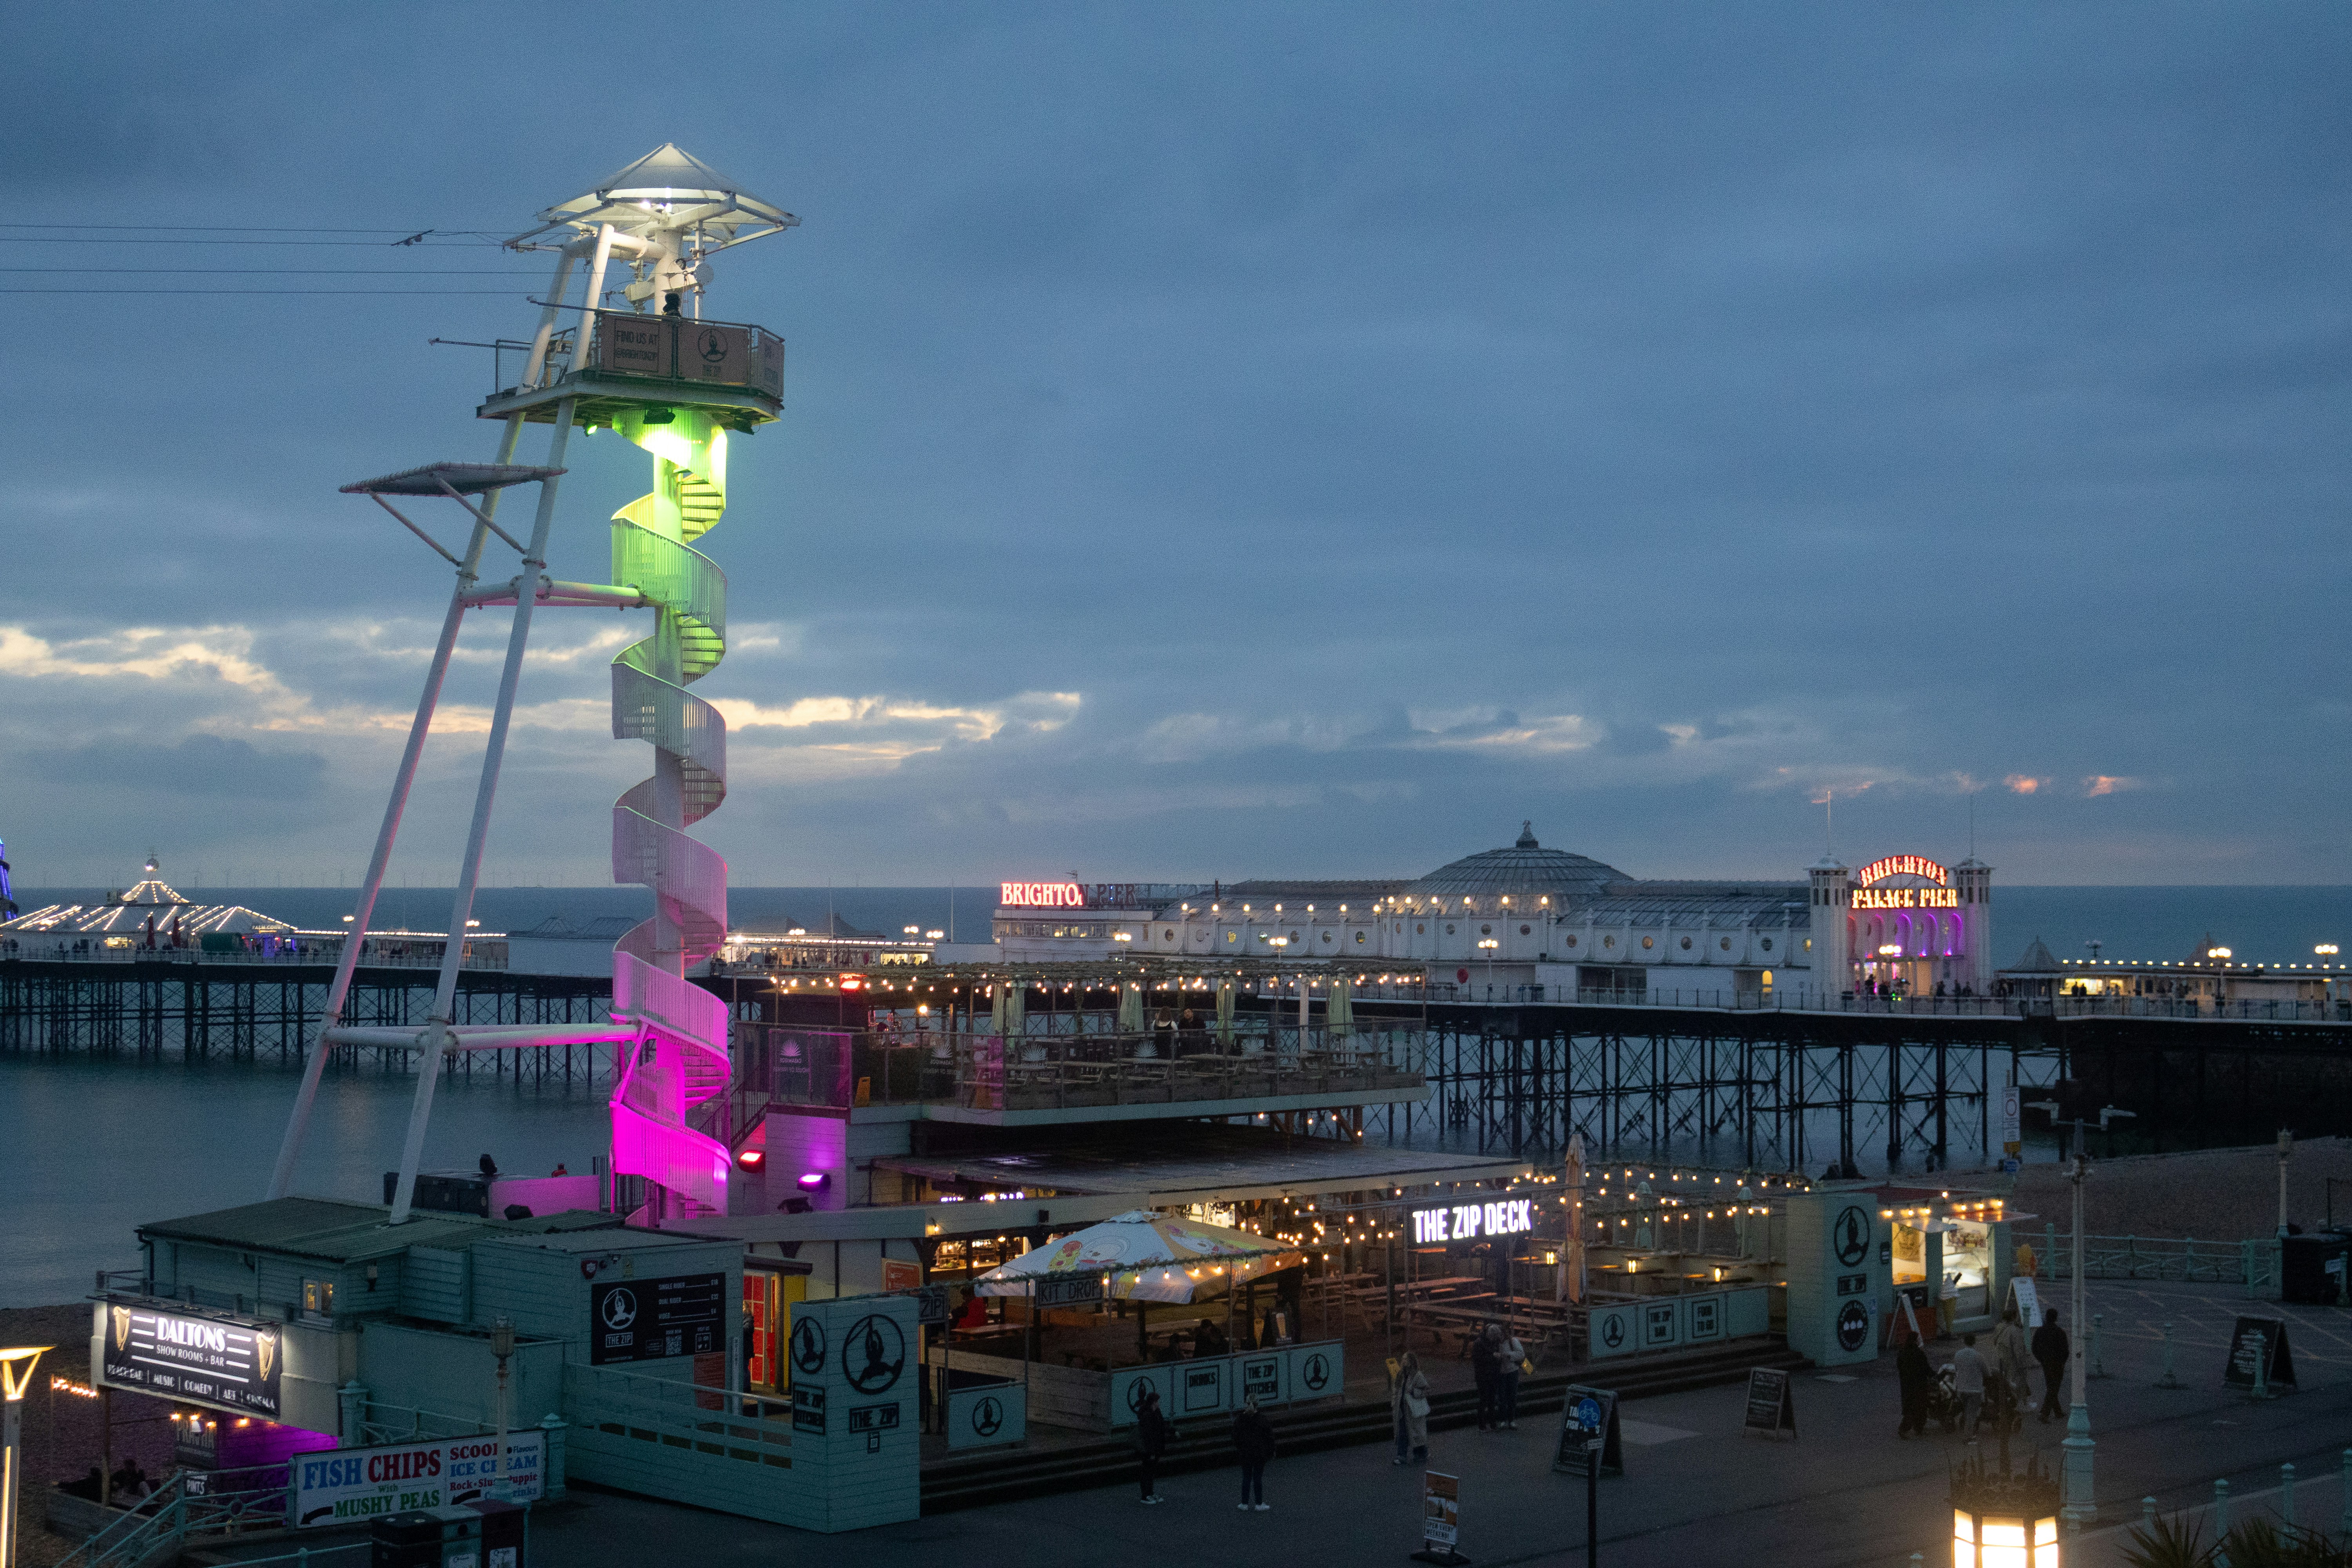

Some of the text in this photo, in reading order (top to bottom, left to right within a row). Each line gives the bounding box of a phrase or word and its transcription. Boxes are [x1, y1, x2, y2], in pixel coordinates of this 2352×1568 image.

[617, 330, 659, 345] FIND US AT
[1860, 855, 1947, 887] BRIGHTON
[1001, 883, 1135, 906] BRIGHTON PIER
[1852, 888, 1958, 909] PALACE PIER
[1413, 1200, 1532, 1243] THE ZIP DECK
[1041, 1283, 1060, 1302] KIT
[1069, 1280, 1098, 1299] DROP
[920, 1298, 941, 1317] ZIP
[157, 1317, 226, 1352] DALTONS
[608, 1334, 631, 1345] THE ZIP
[157, 1345, 176, 1360] SHOW
[178, 1348, 203, 1363] ROOMS
[211, 1355, 224, 1367] BAR
[154, 1374, 174, 1387] MUSIC
[1189, 1373, 1216, 1387] DRINKS
[1248, 1365, 1274, 1379] THE ZIP
[185, 1380, 213, 1395] COMEDY
[223, 1389, 236, 1401] ART
[1245, 1381, 1277, 1395] KITCHEN
[795, 1390, 824, 1408] THE ZIP
[852, 1408, 896, 1428] THE ZIP
[303, 1450, 441, 1490] FISH CHIPS
[450, 1455, 537, 1477] ICE CEAM
[378, 1484, 399, 1493] With
[450, 1480, 472, 1490] Rock
[479, 1477, 495, 1488] Slu
[513, 1486, 537, 1497] rinks
[334, 1490, 440, 1518] MUSHY PEAS
[1439, 1524, 1453, 1532] EVERY
